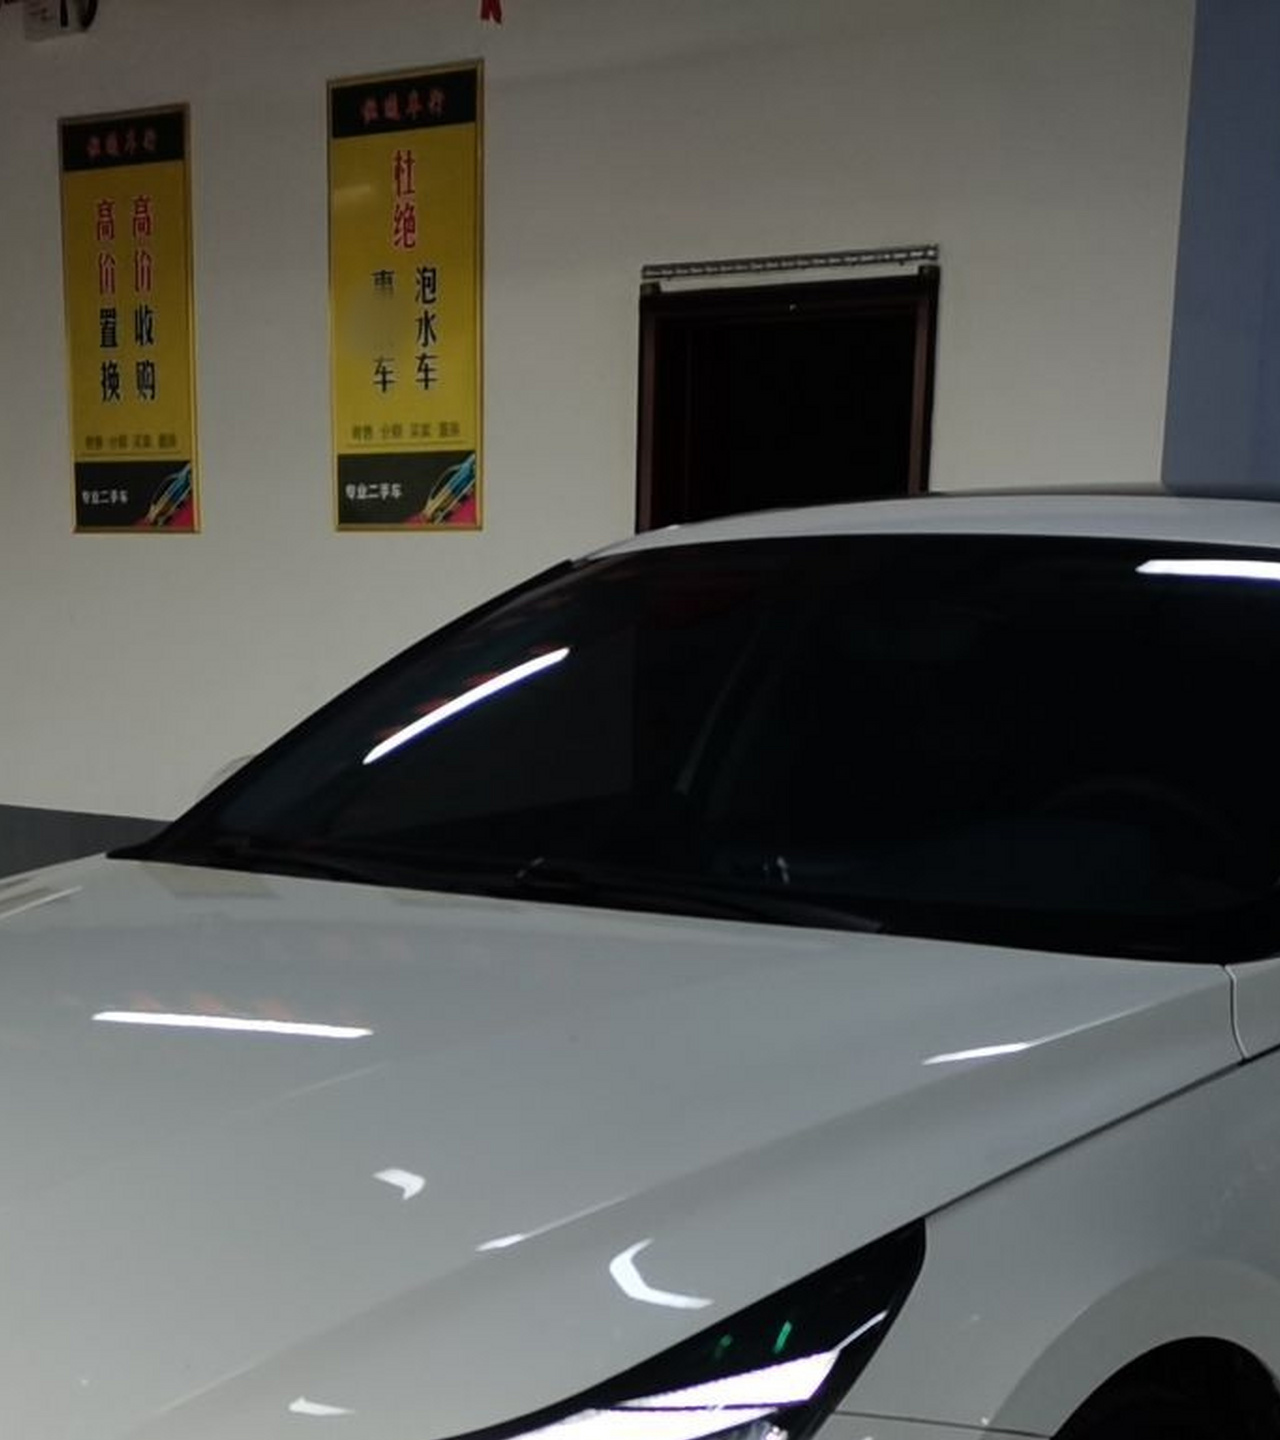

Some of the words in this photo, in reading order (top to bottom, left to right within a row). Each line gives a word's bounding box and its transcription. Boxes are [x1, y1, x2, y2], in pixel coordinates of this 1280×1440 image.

[392, 149, 417, 249] 杜绝
[96, 198, 121, 402] 高价置换
[132, 194, 155, 401] 高价收购
[414, 265, 439, 391] 泡水车
